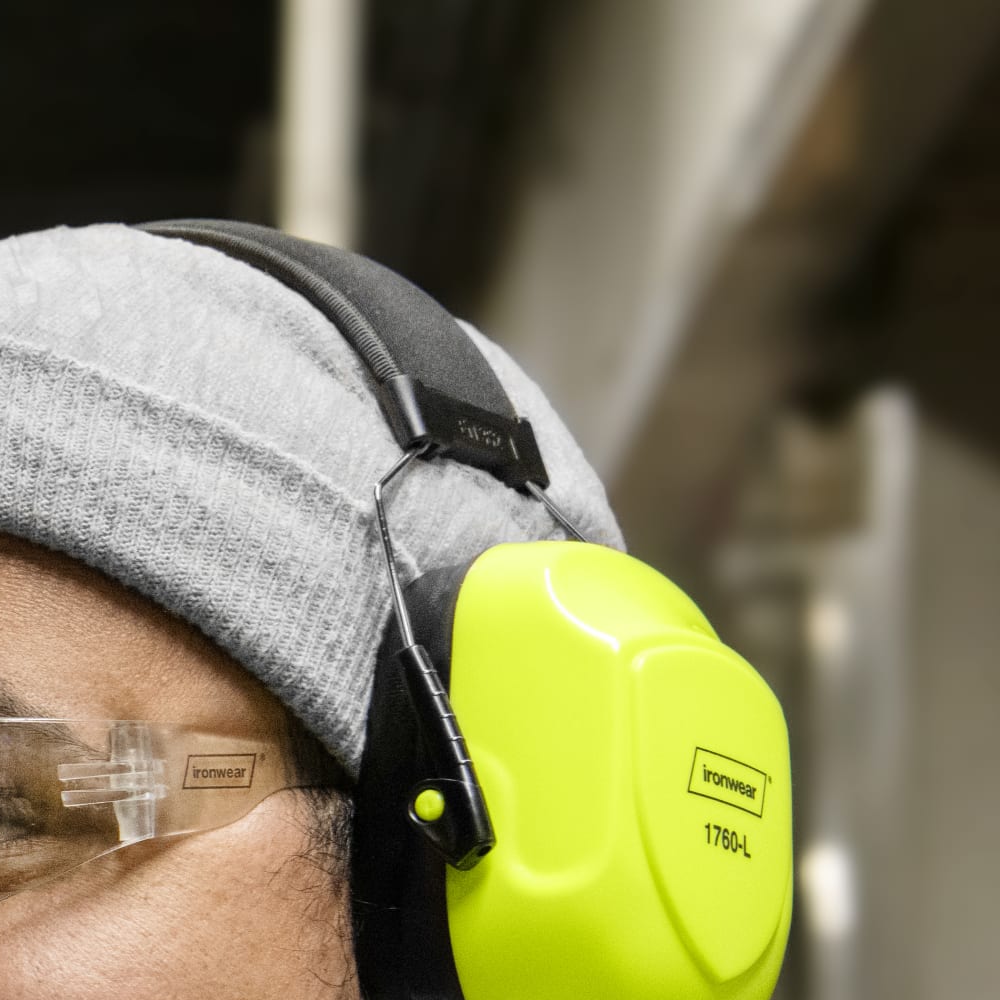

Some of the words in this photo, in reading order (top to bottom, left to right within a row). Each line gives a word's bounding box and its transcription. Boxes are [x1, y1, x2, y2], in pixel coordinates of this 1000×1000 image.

[192, 766, 247, 779] ironwear
[702, 764, 757, 800] ironwear
[704, 822, 752, 859] 1760-L
